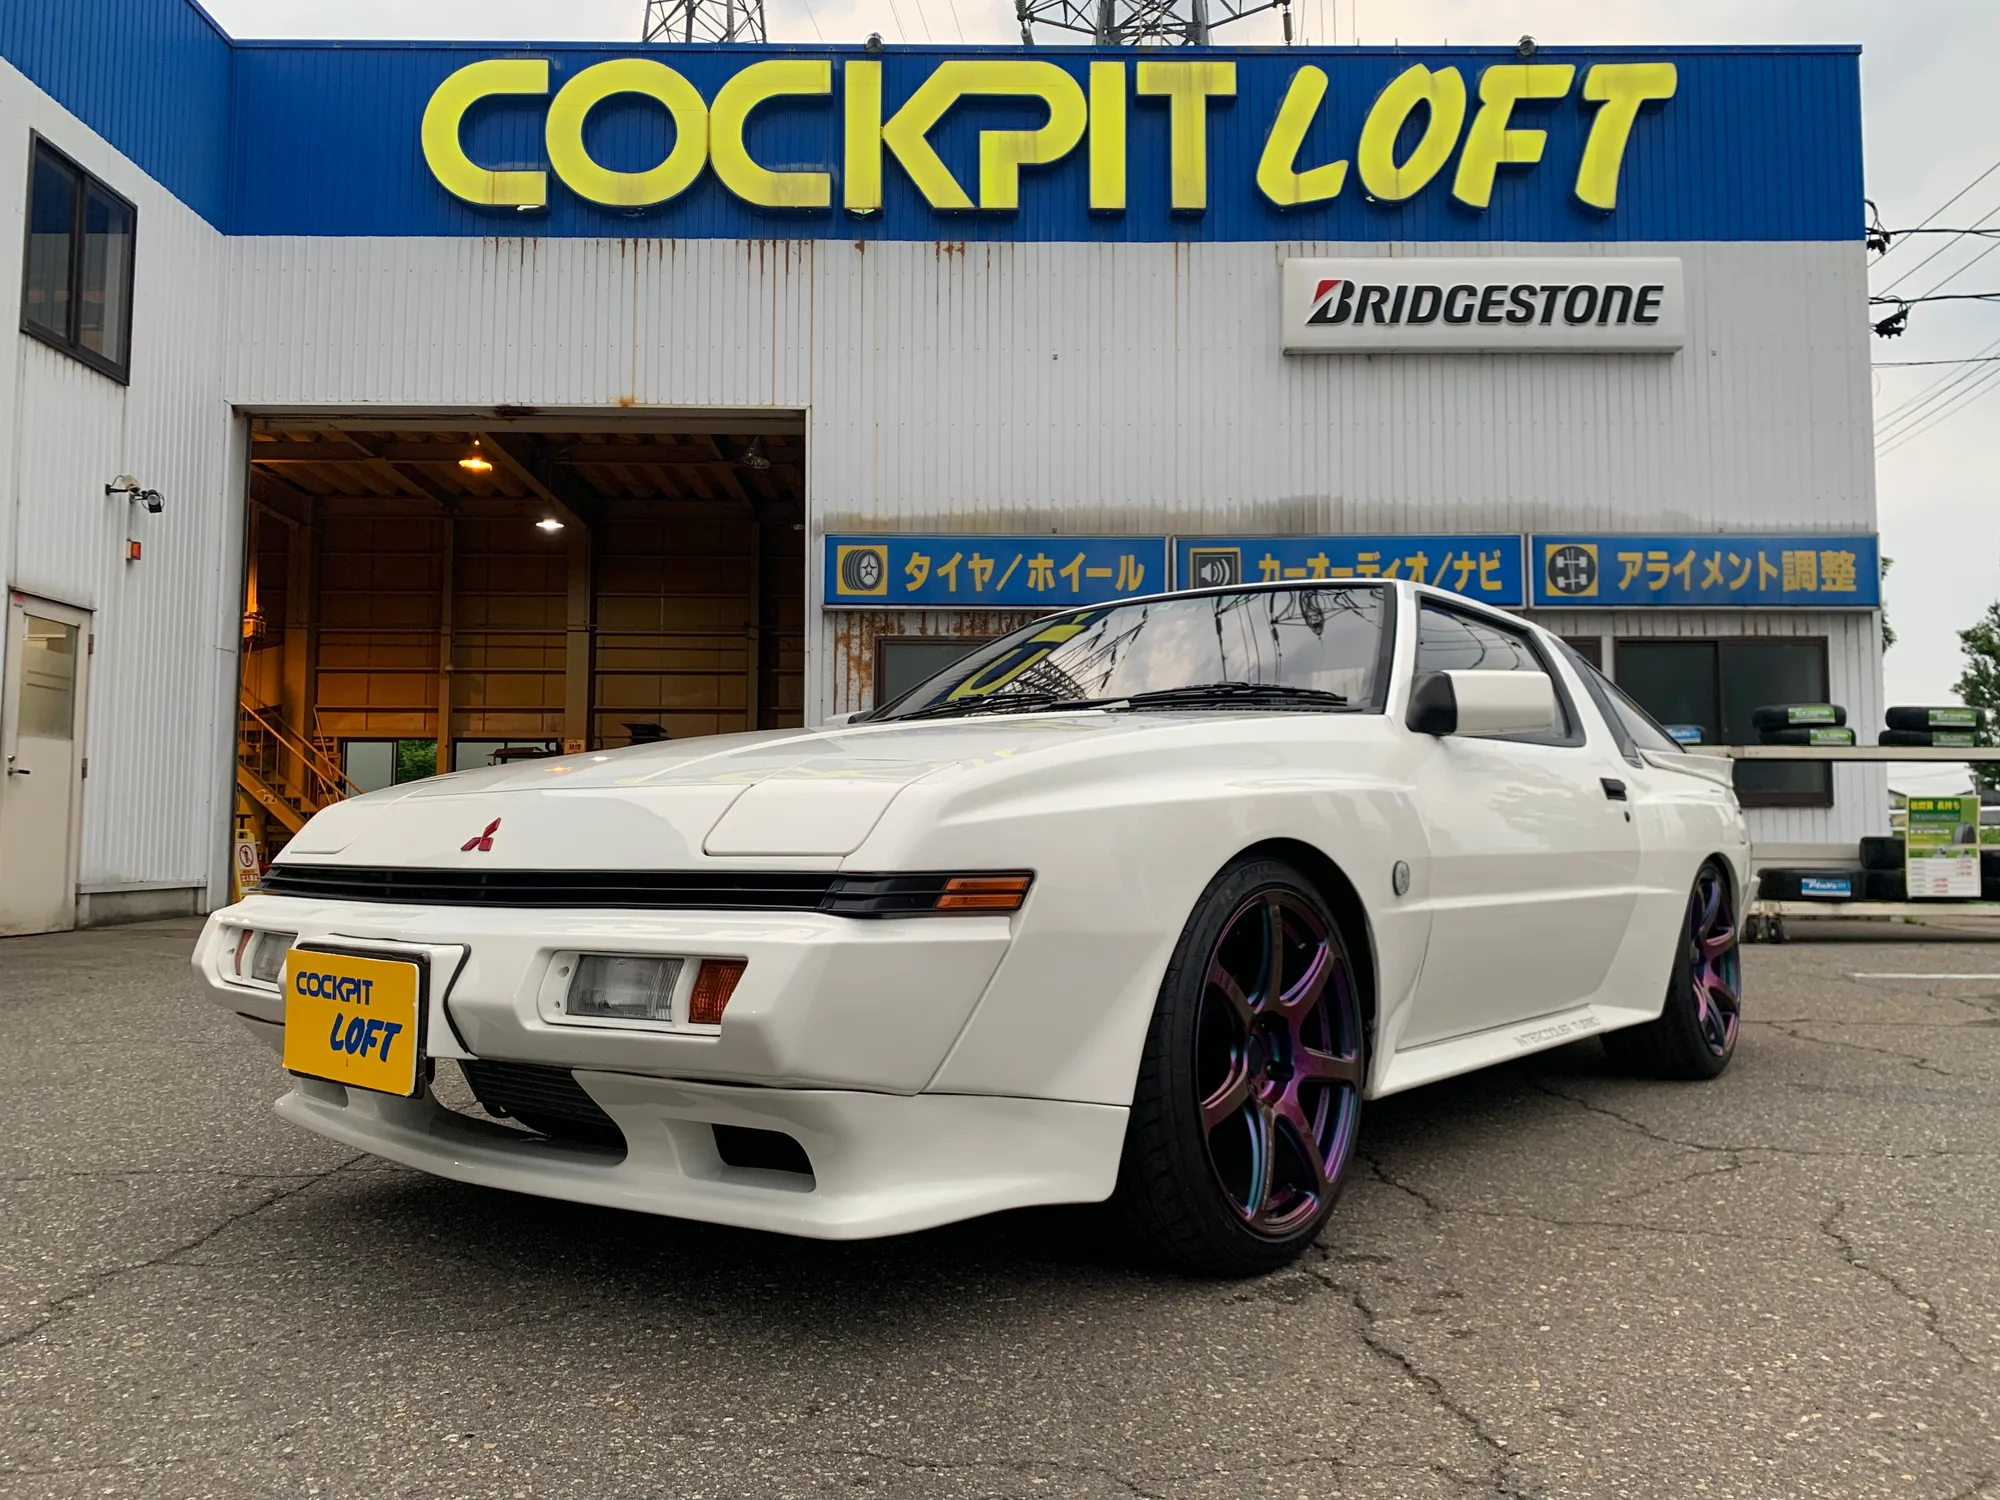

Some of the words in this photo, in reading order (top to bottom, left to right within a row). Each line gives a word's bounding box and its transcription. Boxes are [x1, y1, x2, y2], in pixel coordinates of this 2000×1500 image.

[421, 58, 1238, 212] COCKPIT
[1255, 61, 1678, 211] LOFT
[1306, 279, 1665, 325] BRIDGESTONE
[1617, 549, 1858, 593] アライメント調整
[295, 971, 374, 1006] COCKPIT
[329, 1012, 403, 1063] LOFT
